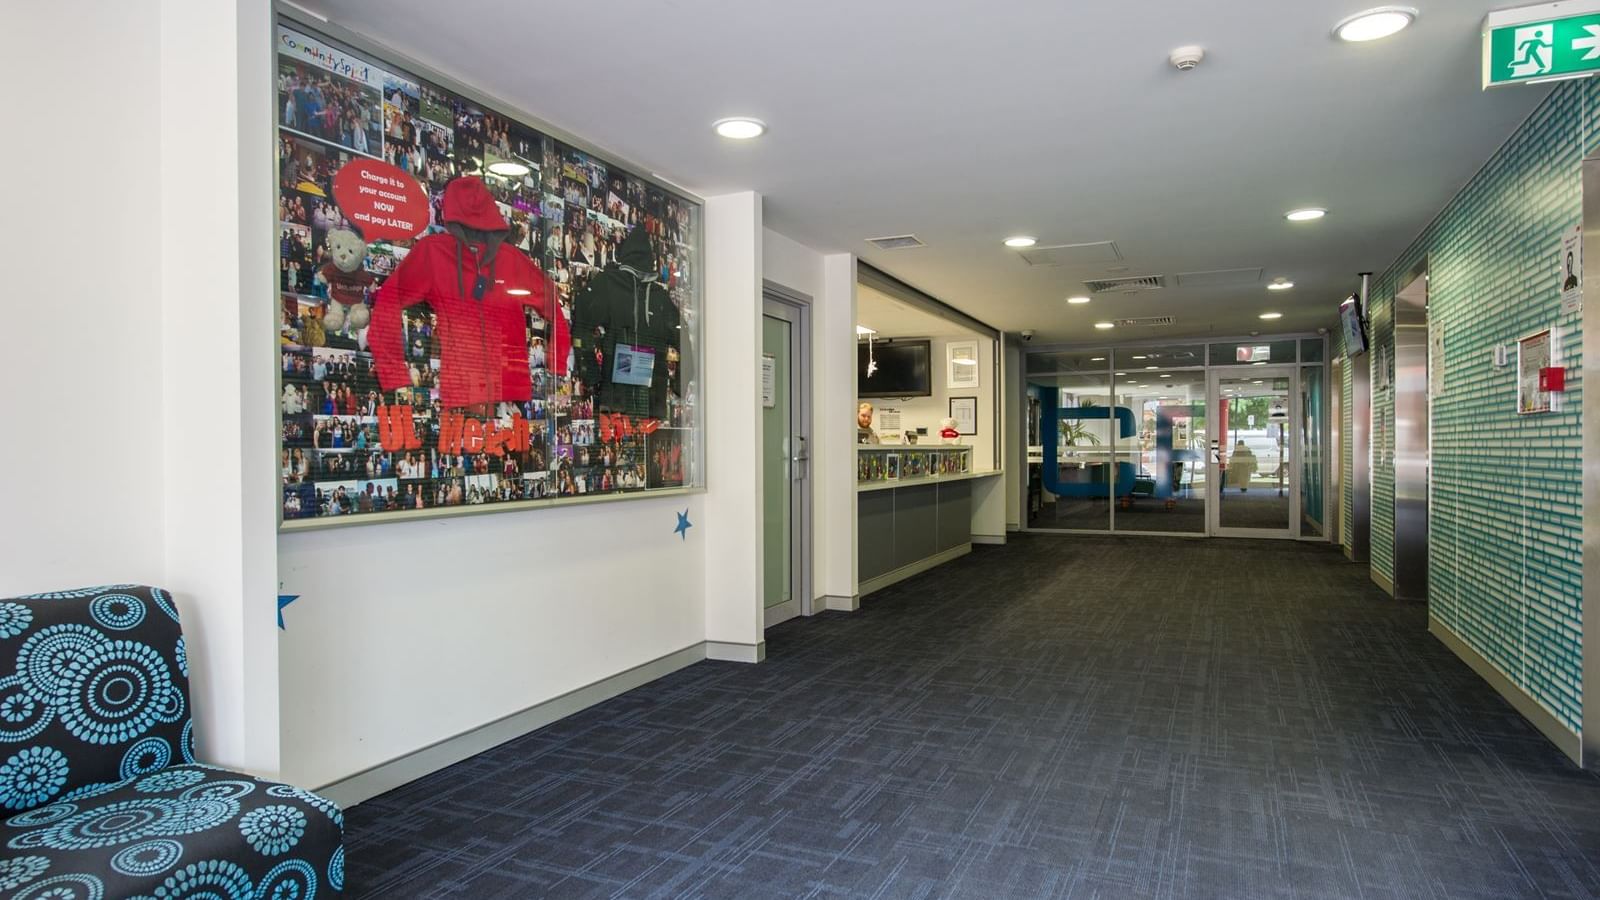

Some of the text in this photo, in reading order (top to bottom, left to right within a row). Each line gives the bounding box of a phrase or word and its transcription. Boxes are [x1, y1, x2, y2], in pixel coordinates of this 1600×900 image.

[360, 170, 405, 189] Charge it to
[359, 185, 407, 203] your account
[373, 201, 395, 213] NOW
[353, 212, 414, 231] and pay LATER!
